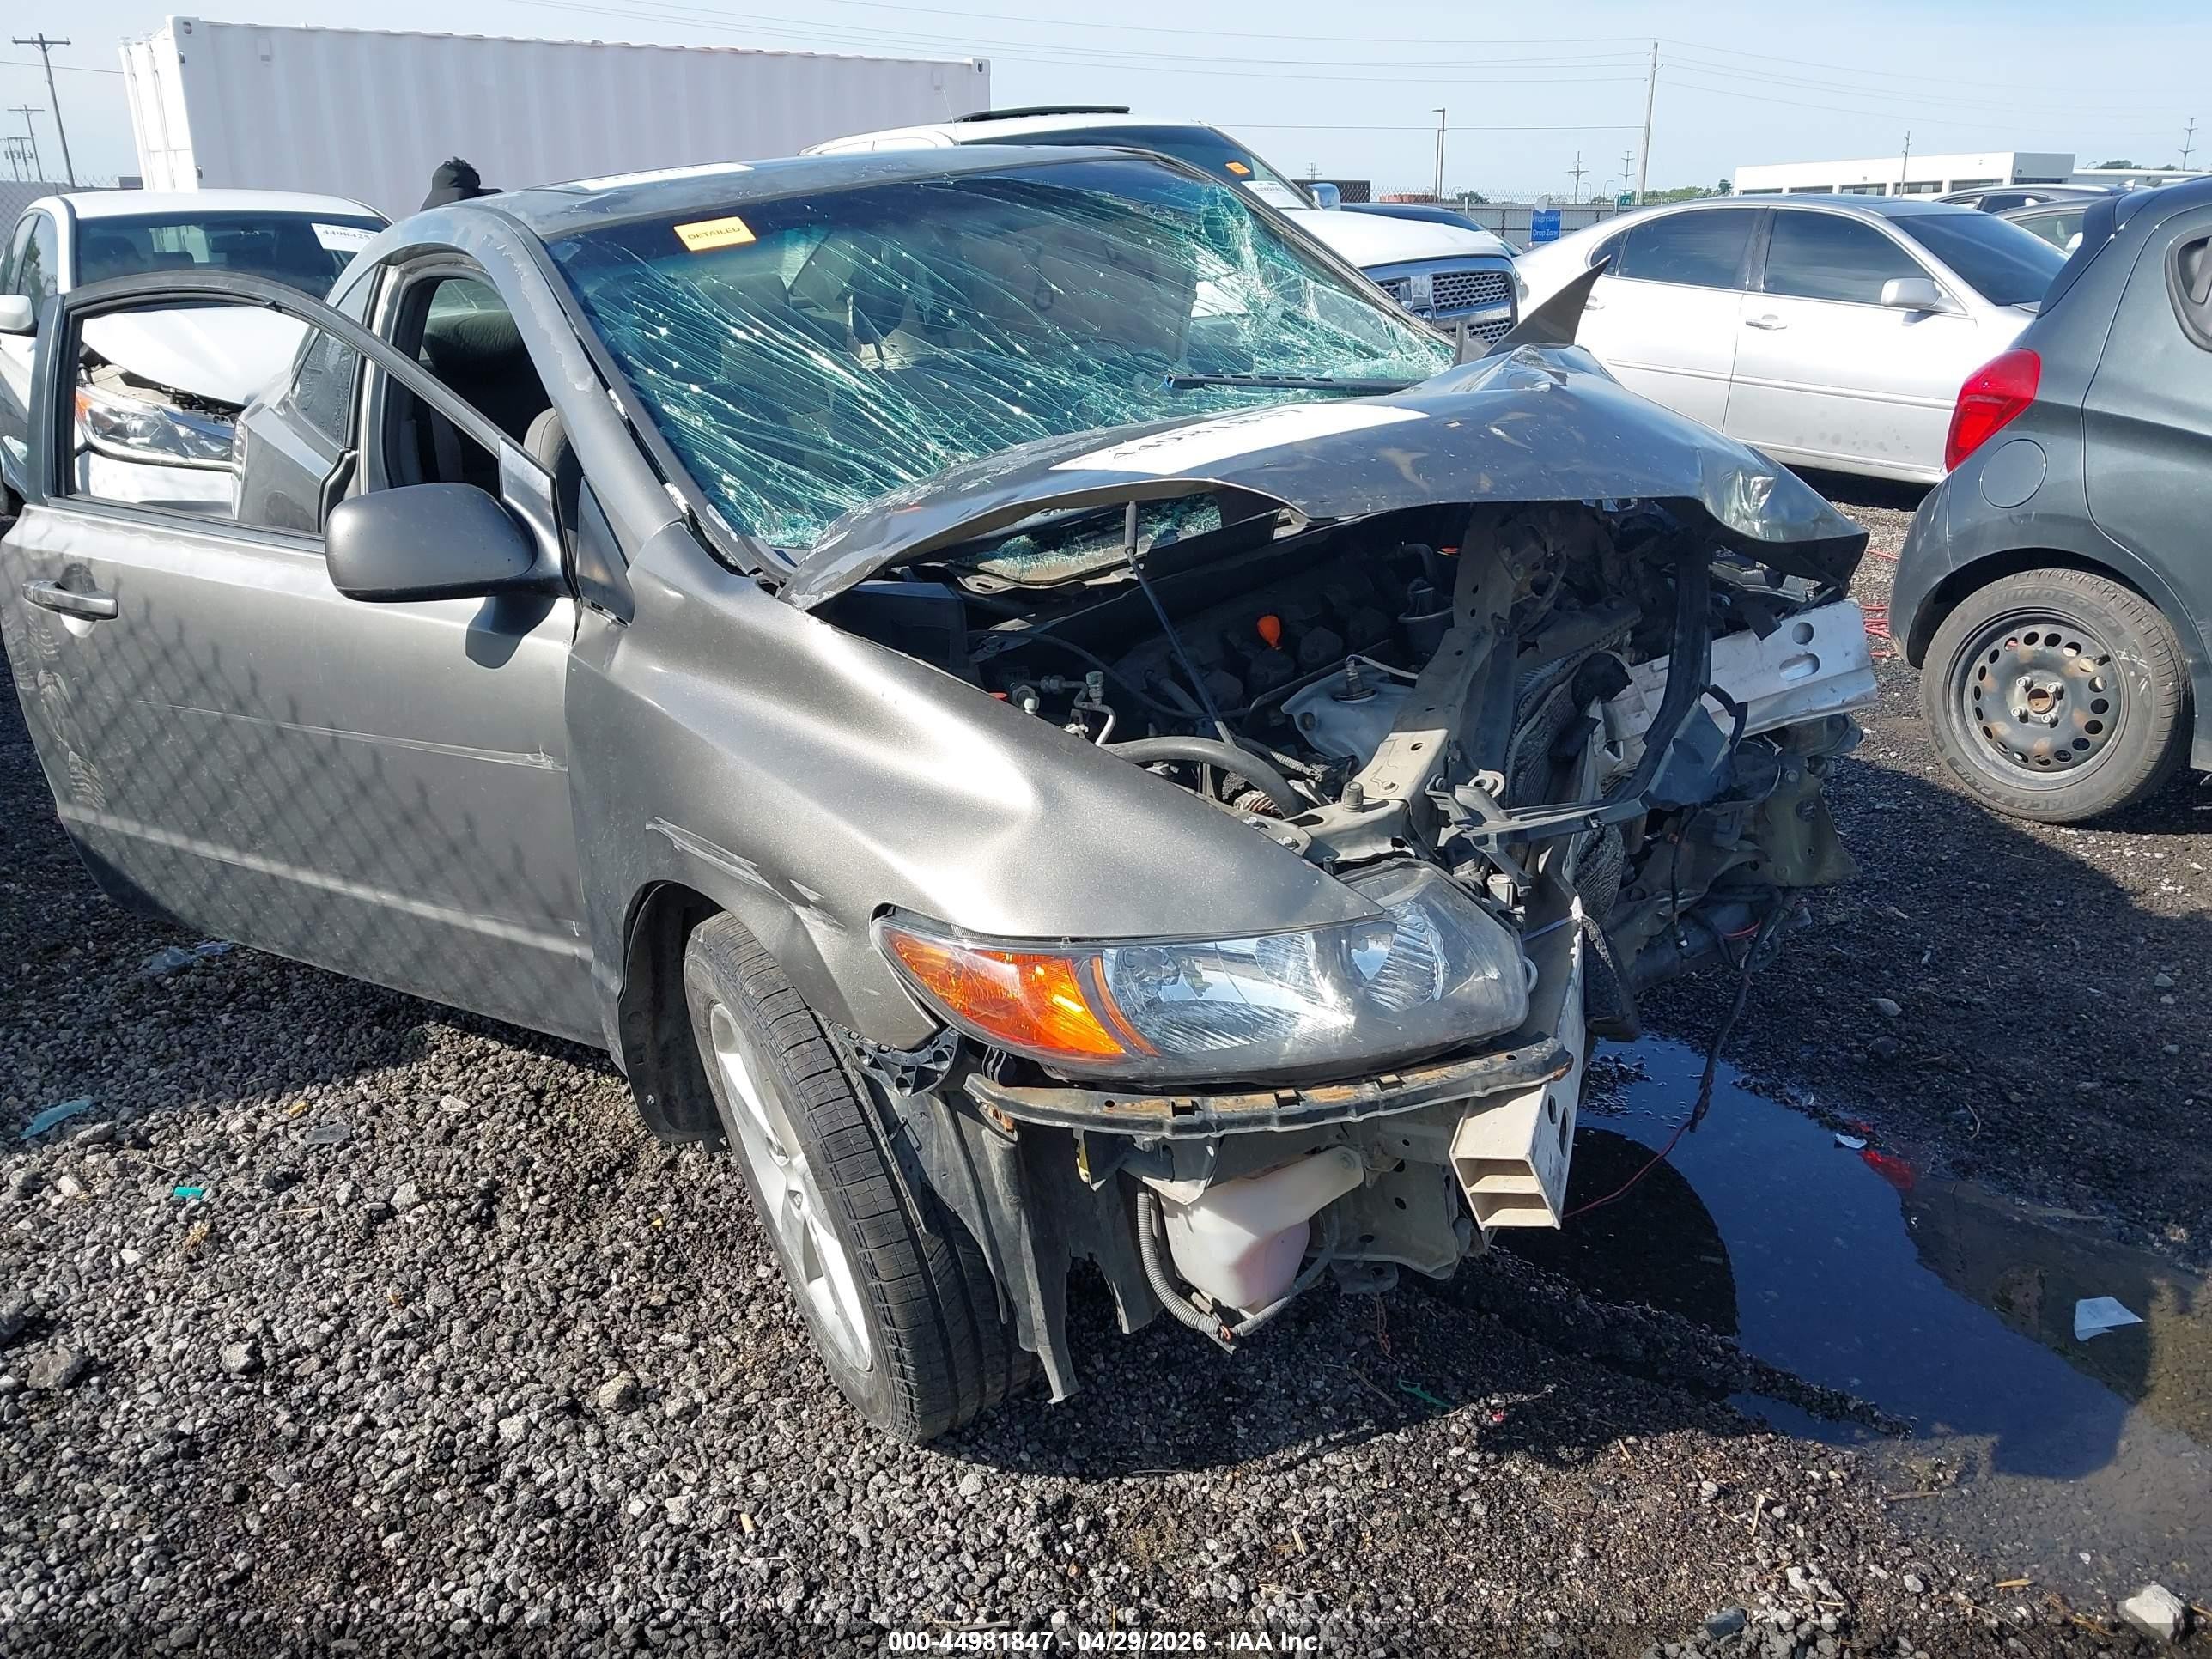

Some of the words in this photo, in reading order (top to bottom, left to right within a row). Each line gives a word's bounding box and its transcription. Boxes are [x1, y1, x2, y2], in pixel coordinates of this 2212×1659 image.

[687, 227, 741, 240] DETAILED
[1533, 228, 1546, 237] Drop
[1954, 765, 1995, 795] PLUS
